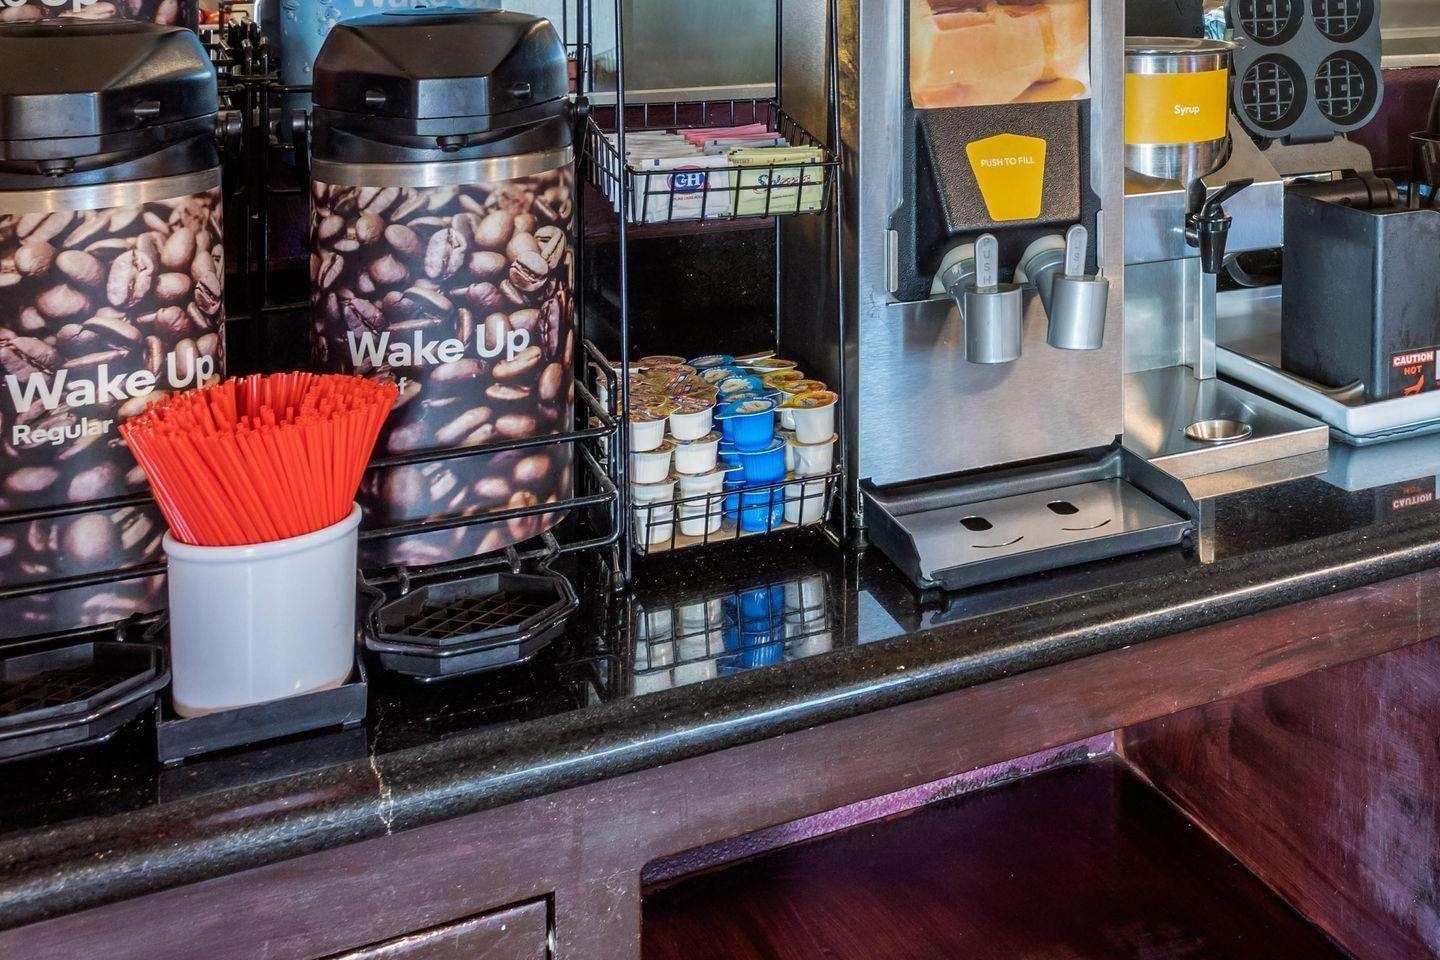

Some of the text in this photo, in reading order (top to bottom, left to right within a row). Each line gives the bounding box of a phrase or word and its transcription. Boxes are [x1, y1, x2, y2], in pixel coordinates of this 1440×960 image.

[1174, 104, 1200, 116] Syrup
[980, 155, 1035, 167] PUSH TO FILL
[347, 323, 530, 367] Wake Up
[1393, 352, 1433, 366] CAUTION
[1404, 365, 1422, 375] HOT
[5, 348, 214, 414] Wake Up
[12, 417, 114, 446] Regular
